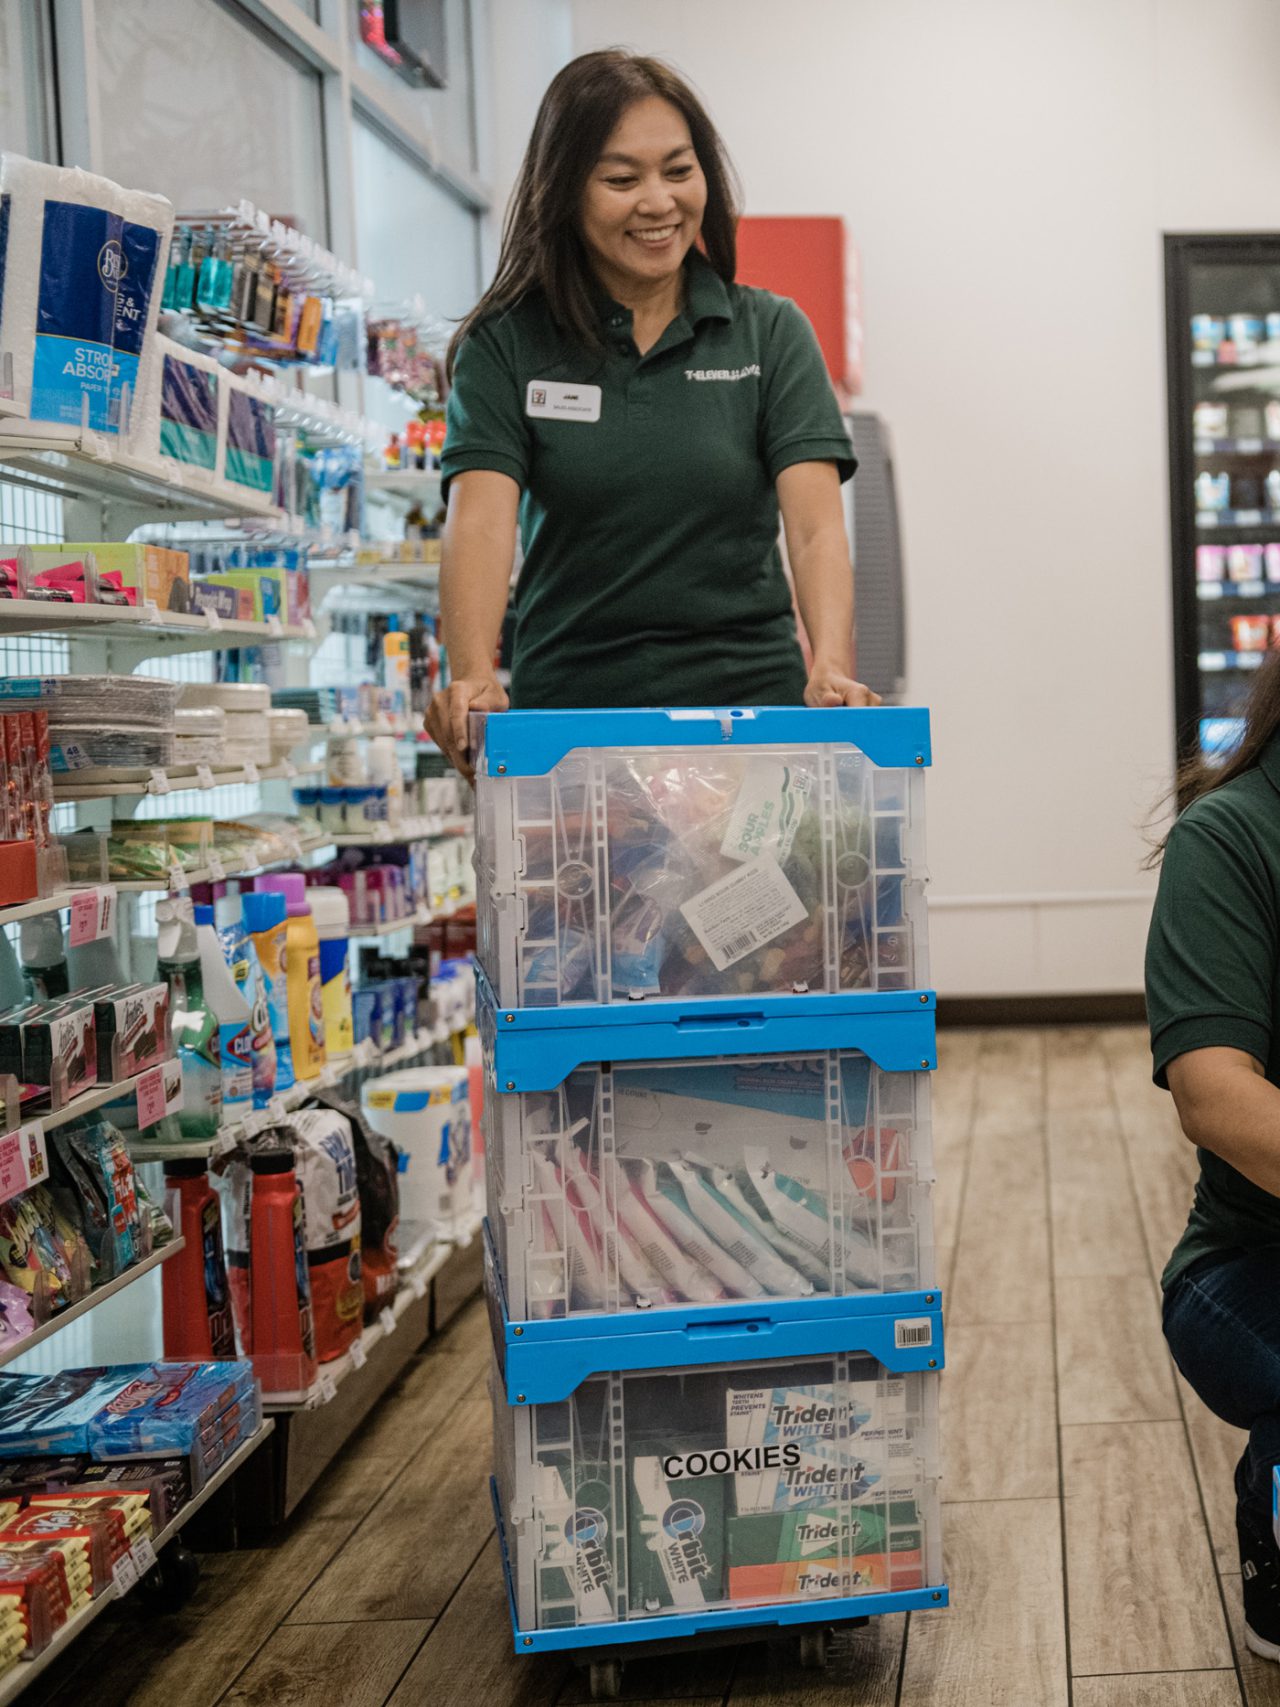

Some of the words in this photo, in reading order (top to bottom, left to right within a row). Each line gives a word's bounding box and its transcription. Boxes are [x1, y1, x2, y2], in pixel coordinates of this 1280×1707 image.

[733, 1392, 764, 1400] WHITENS
[731, 1403, 766, 1411] PREVENTS
[773, 1401, 855, 1426] Trident
[783, 1423, 834, 1437] WHITE
[664, 1443, 800, 1478] COOKIES
[784, 1462, 865, 1485] Trident
[797, 1521, 861, 1541] Trident
[668, 1542, 689, 1584] WHITE
[799, 1571, 861, 1591] Trident
